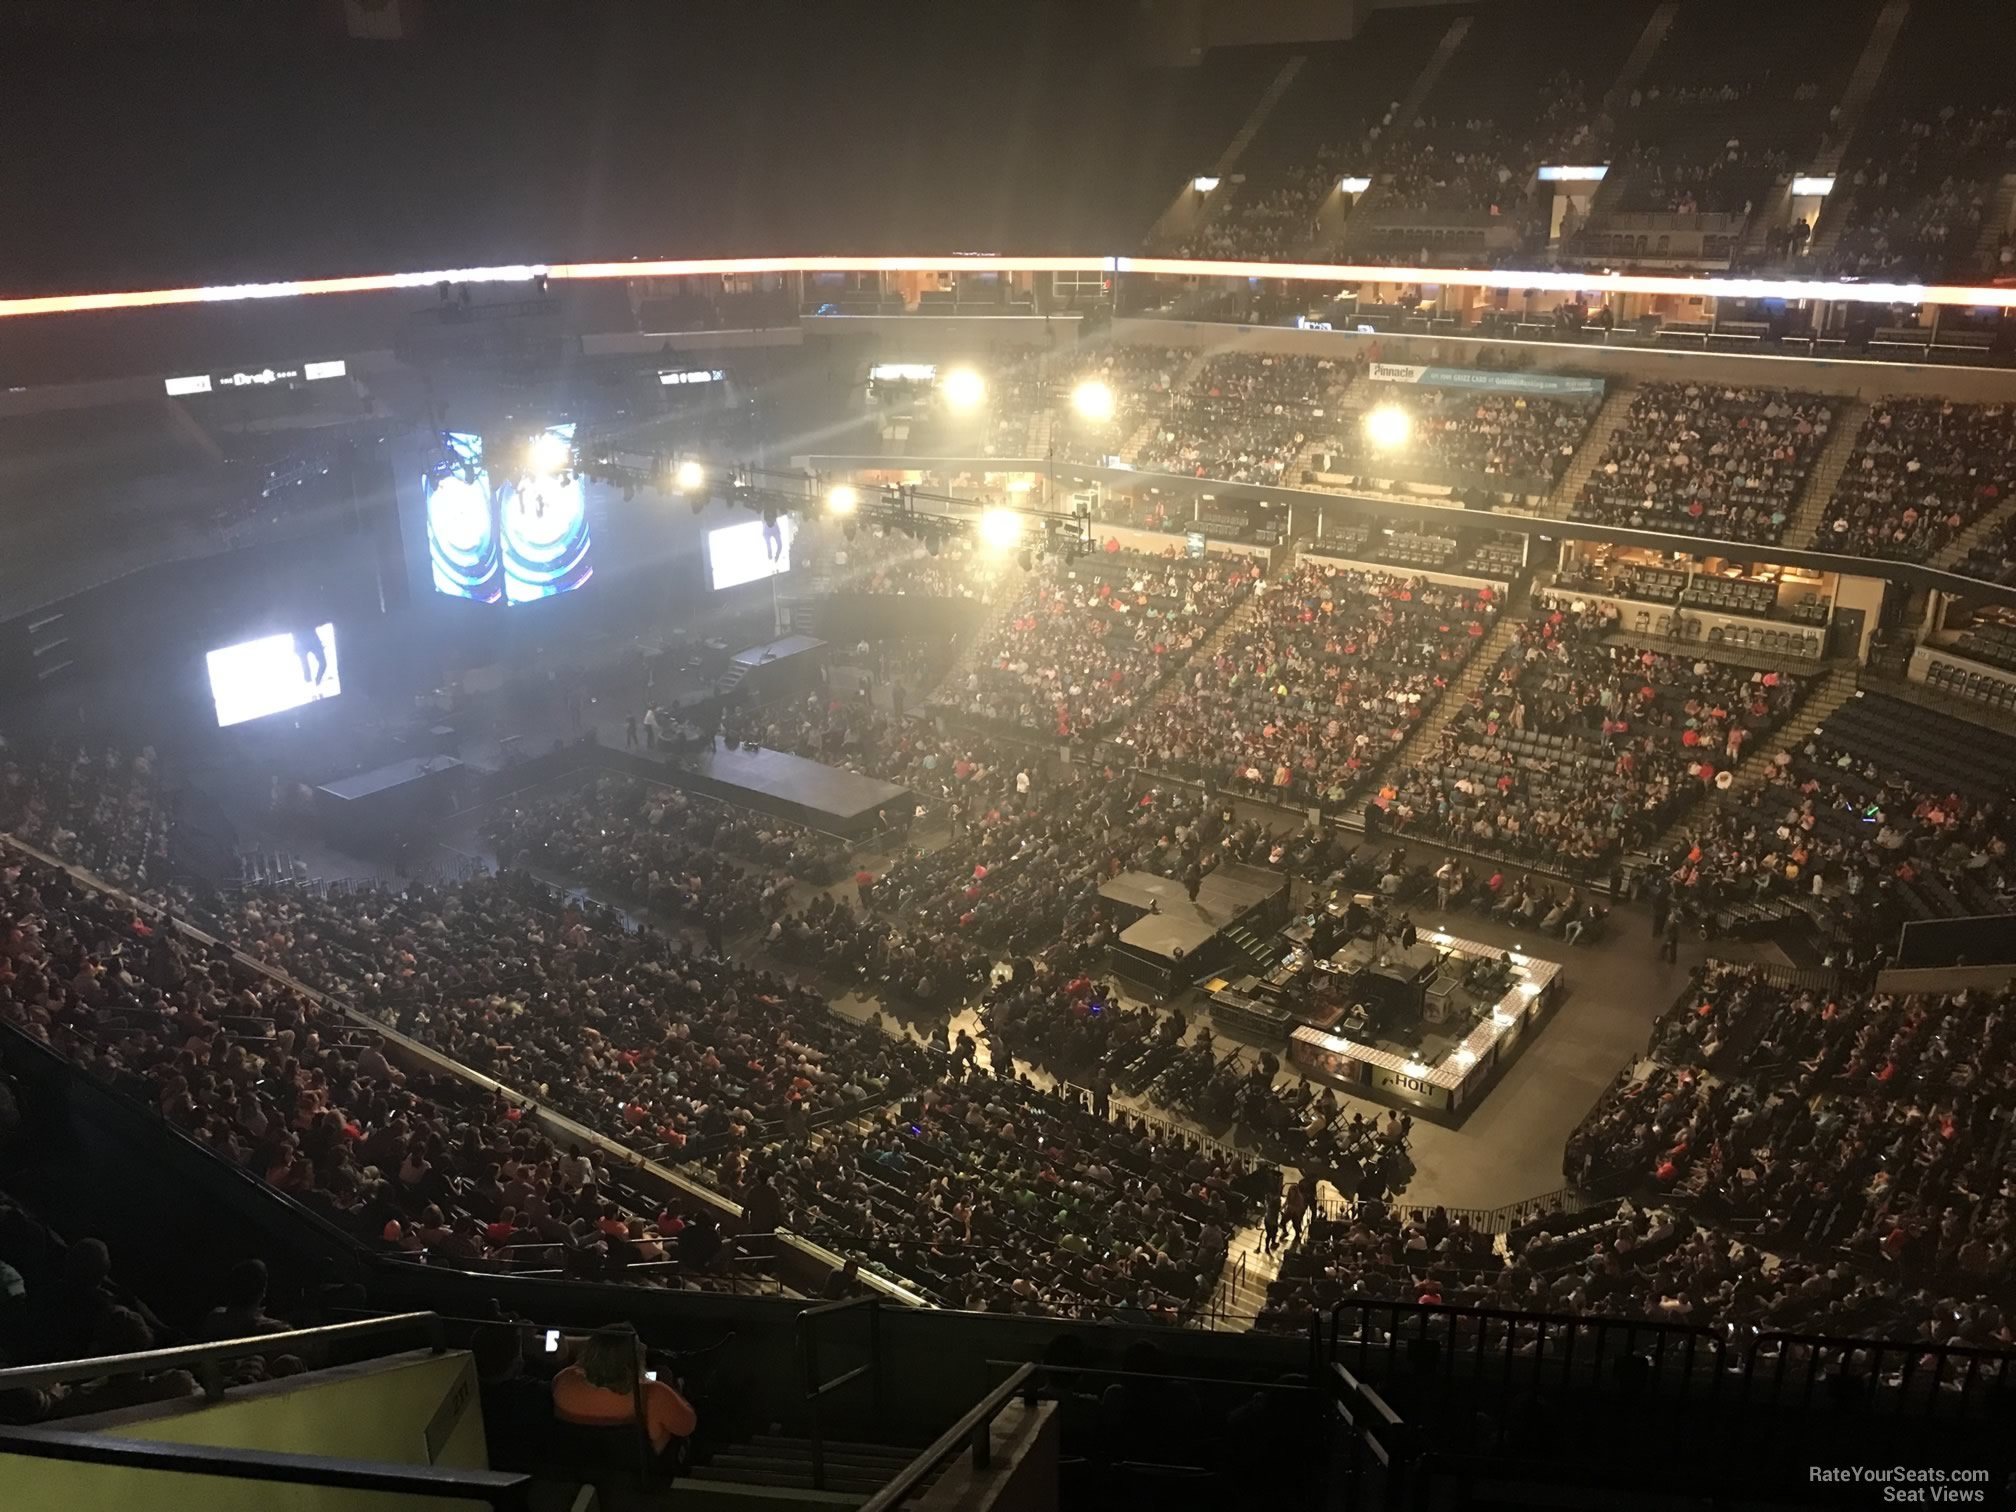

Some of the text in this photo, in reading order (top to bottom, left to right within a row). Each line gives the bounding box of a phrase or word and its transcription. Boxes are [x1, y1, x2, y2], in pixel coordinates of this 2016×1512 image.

[1374, 364, 1414, 378] Pinnacle
[1471, 375, 1487, 383] CARD
[1395, 1074, 1436, 1096] HOLT
